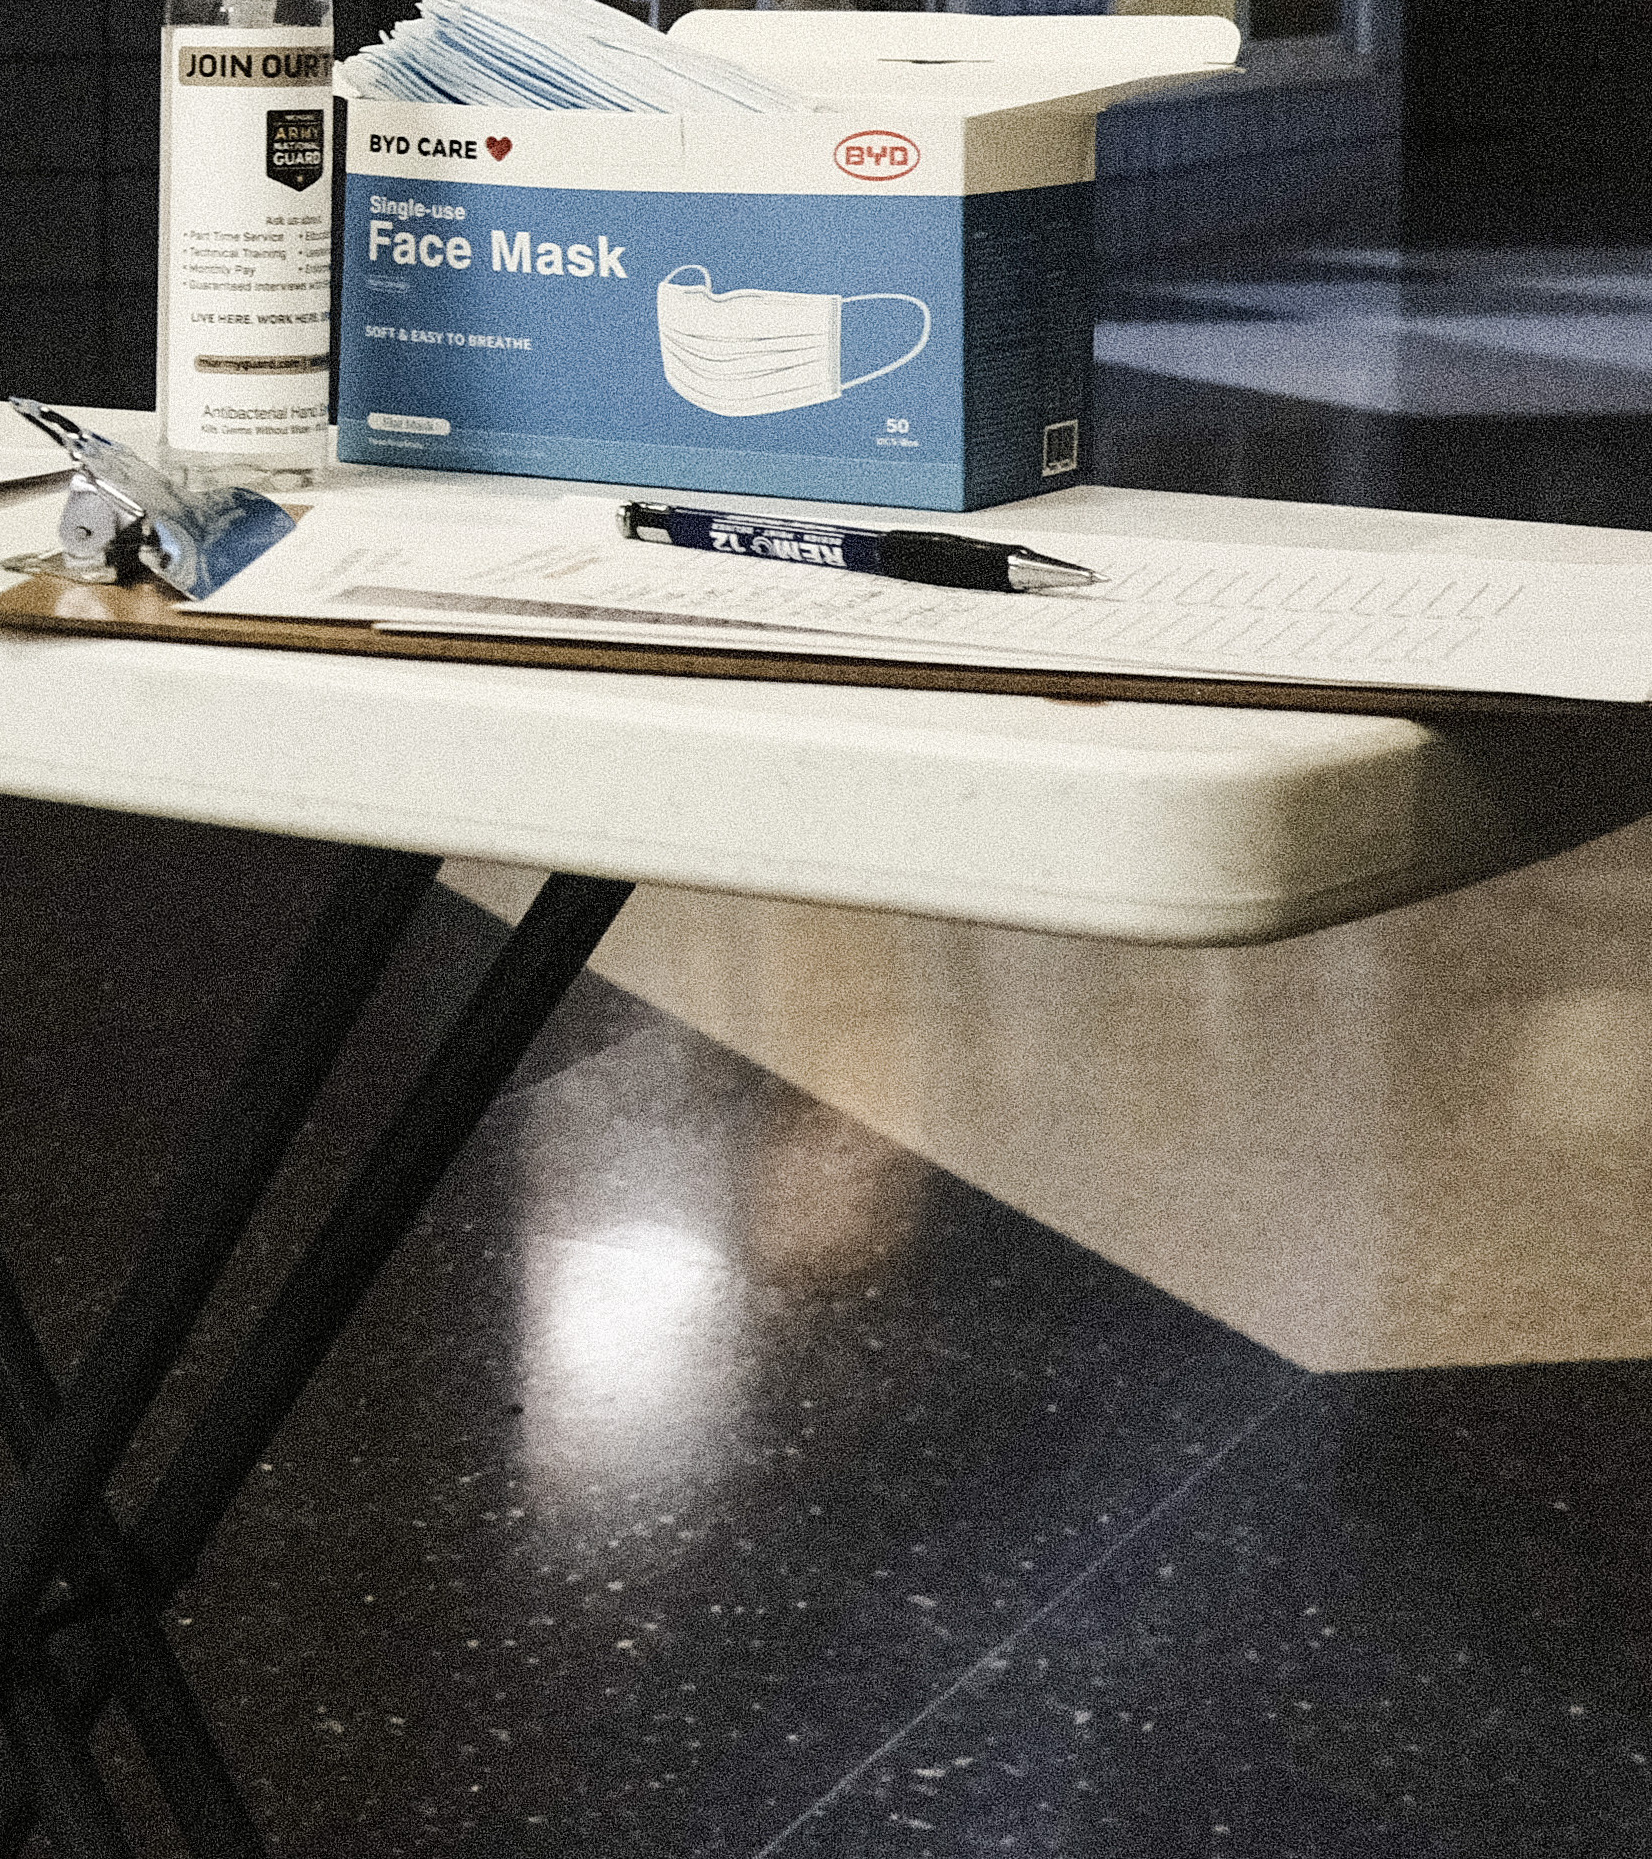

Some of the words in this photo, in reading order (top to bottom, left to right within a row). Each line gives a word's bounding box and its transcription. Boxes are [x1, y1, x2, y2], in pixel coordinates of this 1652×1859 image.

[186, 54, 252, 78] JOIN
[262, 53, 318, 79] OUR
[274, 126, 320, 140] ARMY
[369, 134, 411, 155] BYD
[417, 137, 478, 160] CARE
[273, 151, 321, 166] GUARD
[844, 145, 909, 167] BYD
[369, 195, 467, 221] Single-use
[190, 230, 210, 241] Part
[213, 231, 240, 241] Time
[243, 232, 284, 243] Service
[190, 246, 238, 258] Technical
[242, 247, 286, 261] Training
[368, 219, 473, 270] Face
[491, 229, 628, 279] Mask
[189, 264, 231, 276] Monthly
[235, 264, 255, 278] Pay
[191, 313, 215, 324] LIVE
[256, 314, 294, 325] WORK
[364, 325, 396, 339] SOFT
[398, 328, 409, 340] &
[410, 328, 444, 344] EASY
[446, 332, 466, 346] TO
[468, 334, 532, 351] BREATHE
[202, 404, 288, 420] Antibacterial
[886, 418, 910, 434] 50
[709, 531, 747, 554] 12
